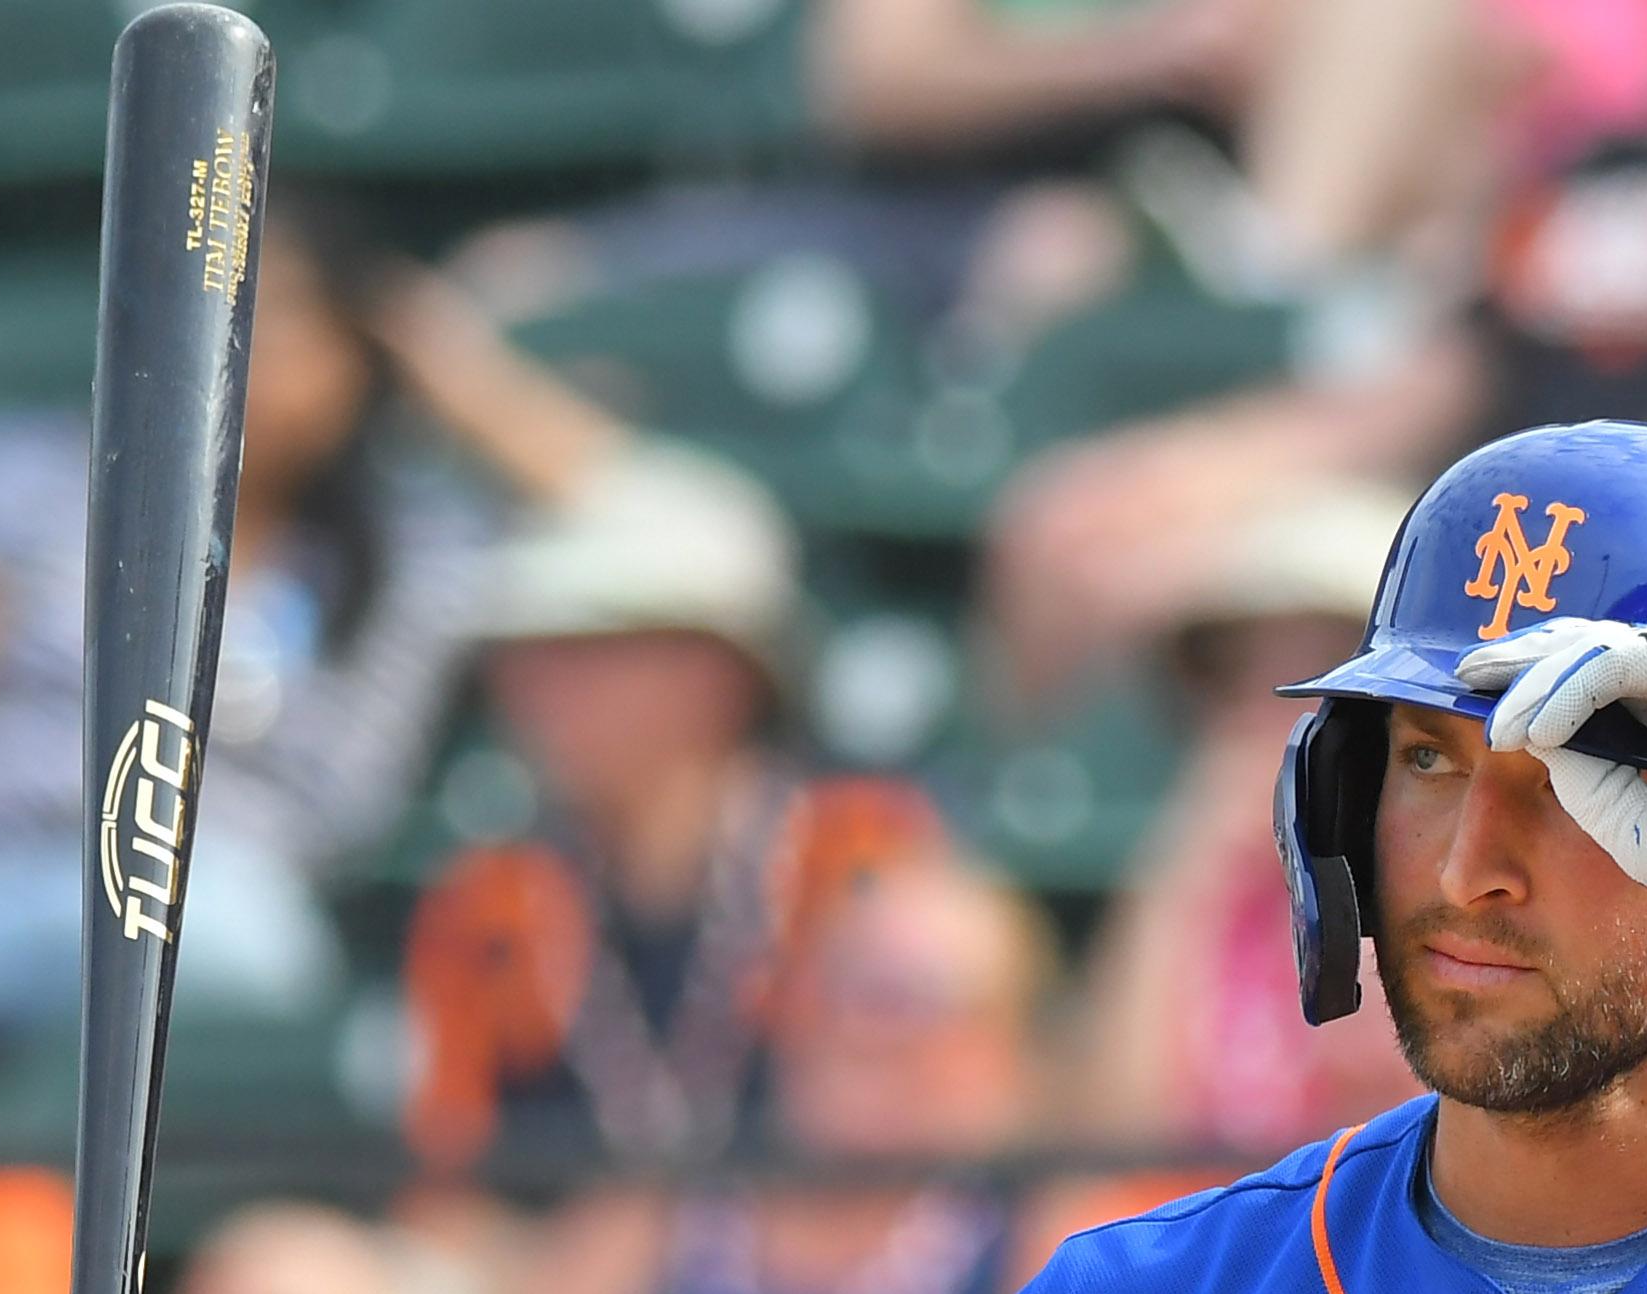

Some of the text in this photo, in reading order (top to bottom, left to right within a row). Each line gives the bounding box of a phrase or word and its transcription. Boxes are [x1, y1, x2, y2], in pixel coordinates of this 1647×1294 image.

[186, 159, 209, 250] TL-327-M
[204, 128, 234, 292] TIM TEBOW
[1465, 492, 1586, 641] NY
[123, 699, 195, 944] TUCCI
